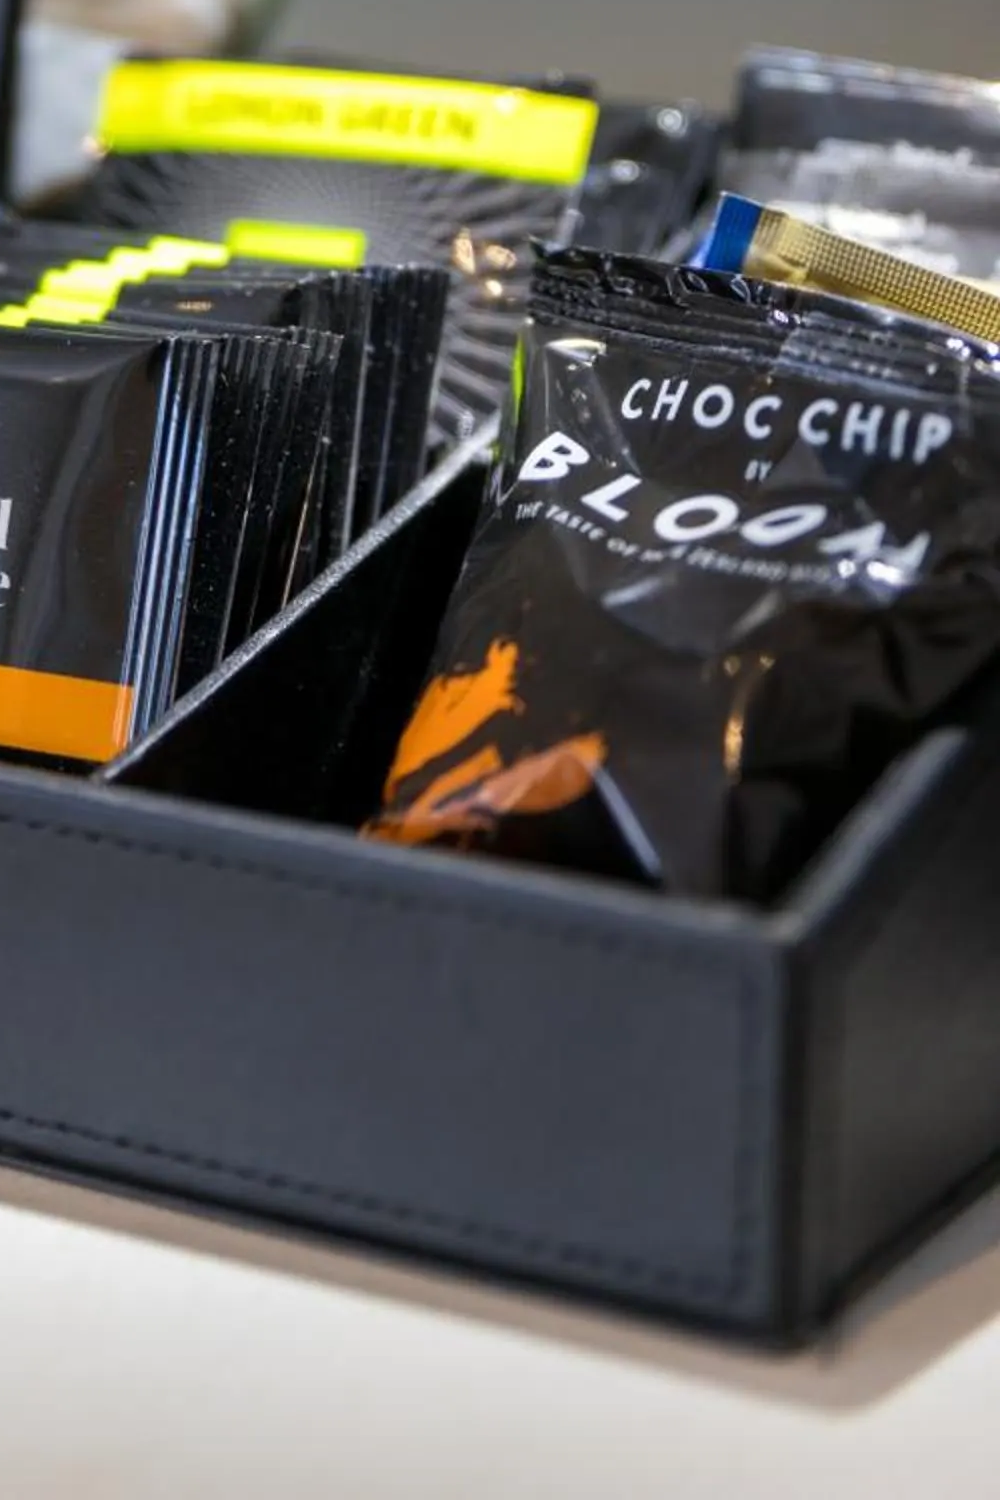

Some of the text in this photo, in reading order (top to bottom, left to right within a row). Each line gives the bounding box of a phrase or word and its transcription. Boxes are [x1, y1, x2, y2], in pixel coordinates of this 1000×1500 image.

[620, 378, 952, 465] CHOC CHIP
[744, 459, 773, 483] BY
[515, 499, 544, 521] THE
[544, 503, 607, 541] TASTE
[606, 537, 640, 558] OF
